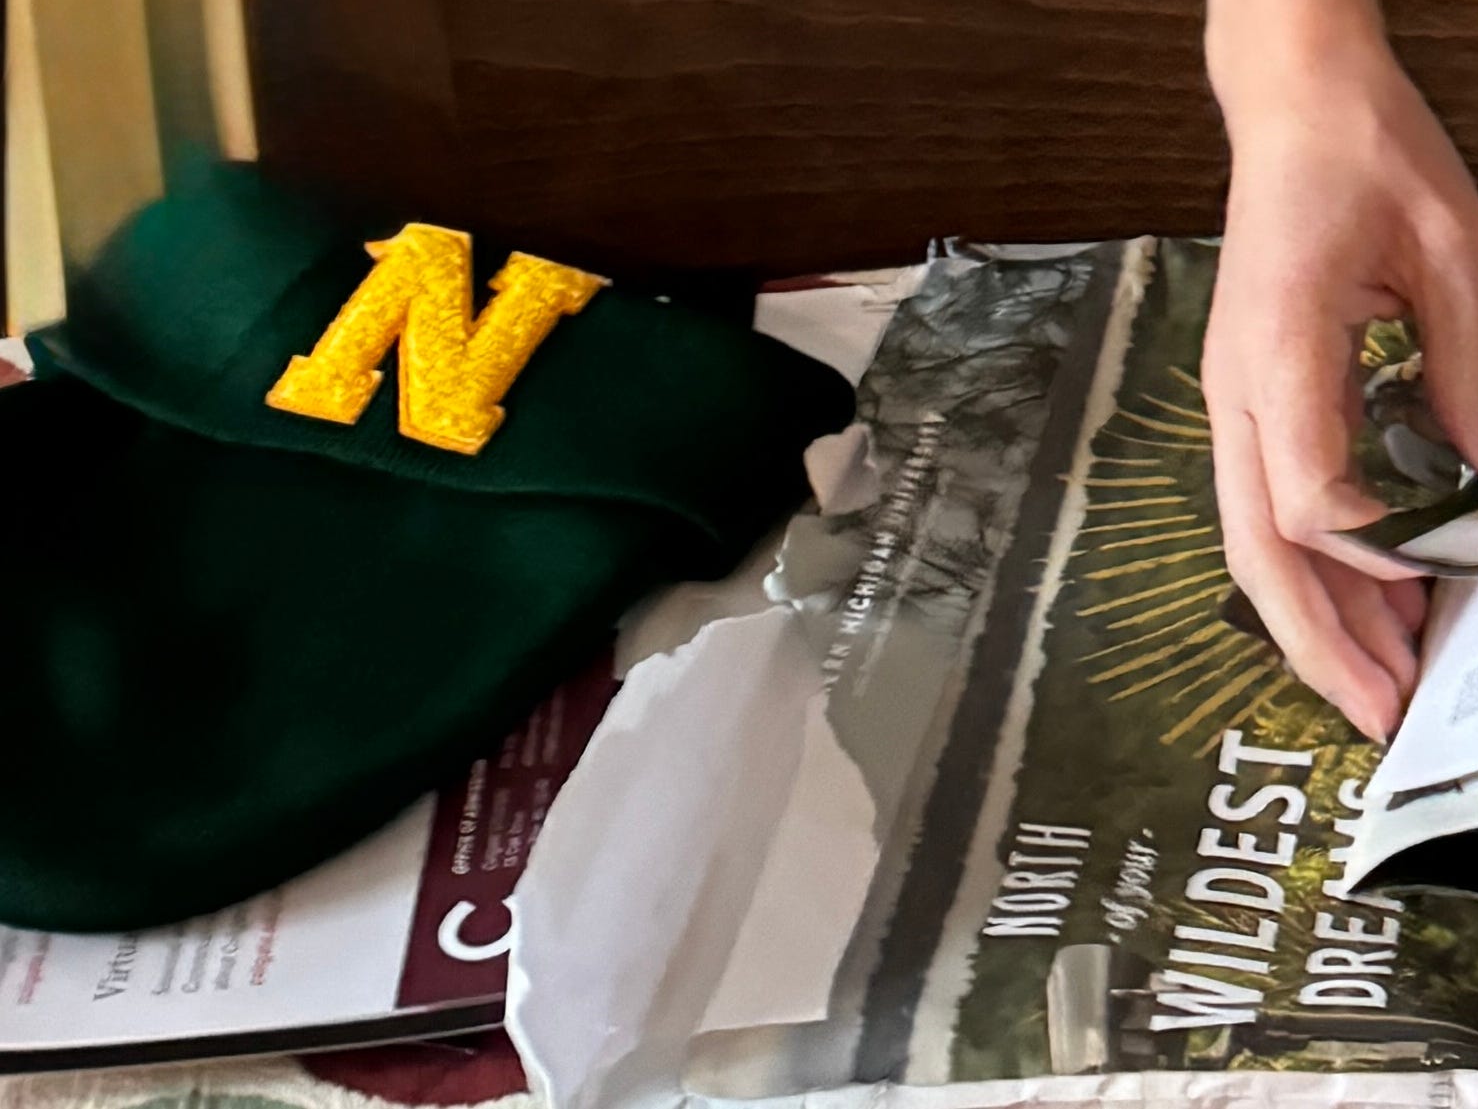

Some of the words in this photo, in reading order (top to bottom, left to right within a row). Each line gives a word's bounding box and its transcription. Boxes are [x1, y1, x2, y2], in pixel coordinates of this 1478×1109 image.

[264, 222, 609, 456] N
[982, 822, 1093, 937] NORTH
[1100, 897, 1150, 930] of
[1113, 839, 1159, 900] your
[1149, 729, 1316, 1032] WILDEST
